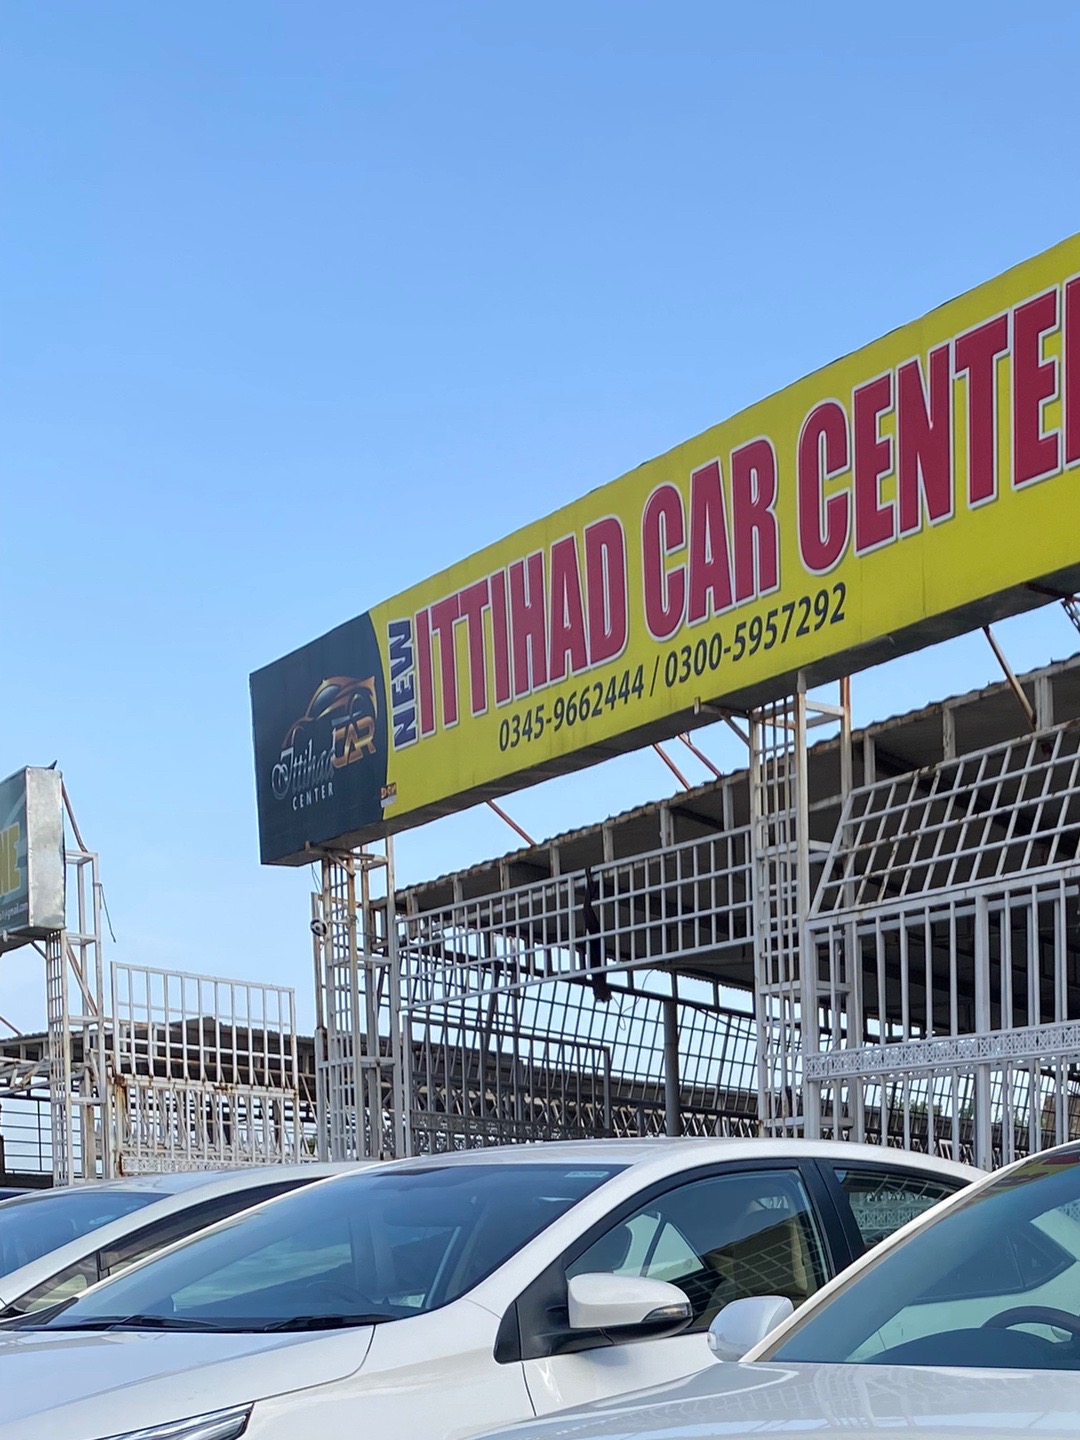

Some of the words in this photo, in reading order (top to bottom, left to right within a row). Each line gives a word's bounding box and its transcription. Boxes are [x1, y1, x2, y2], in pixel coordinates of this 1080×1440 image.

[414, 516, 630, 738] ITTIHAD
[641, 436, 780, 642] CAR
[387, 616, 418, 752] NEW
[499, 664, 645, 752] 0345-9662444
[664, 582, 847, 688] 0300-5957292
[291, 781, 334, 811] CENTER
[331, 715, 377, 769] CAR
